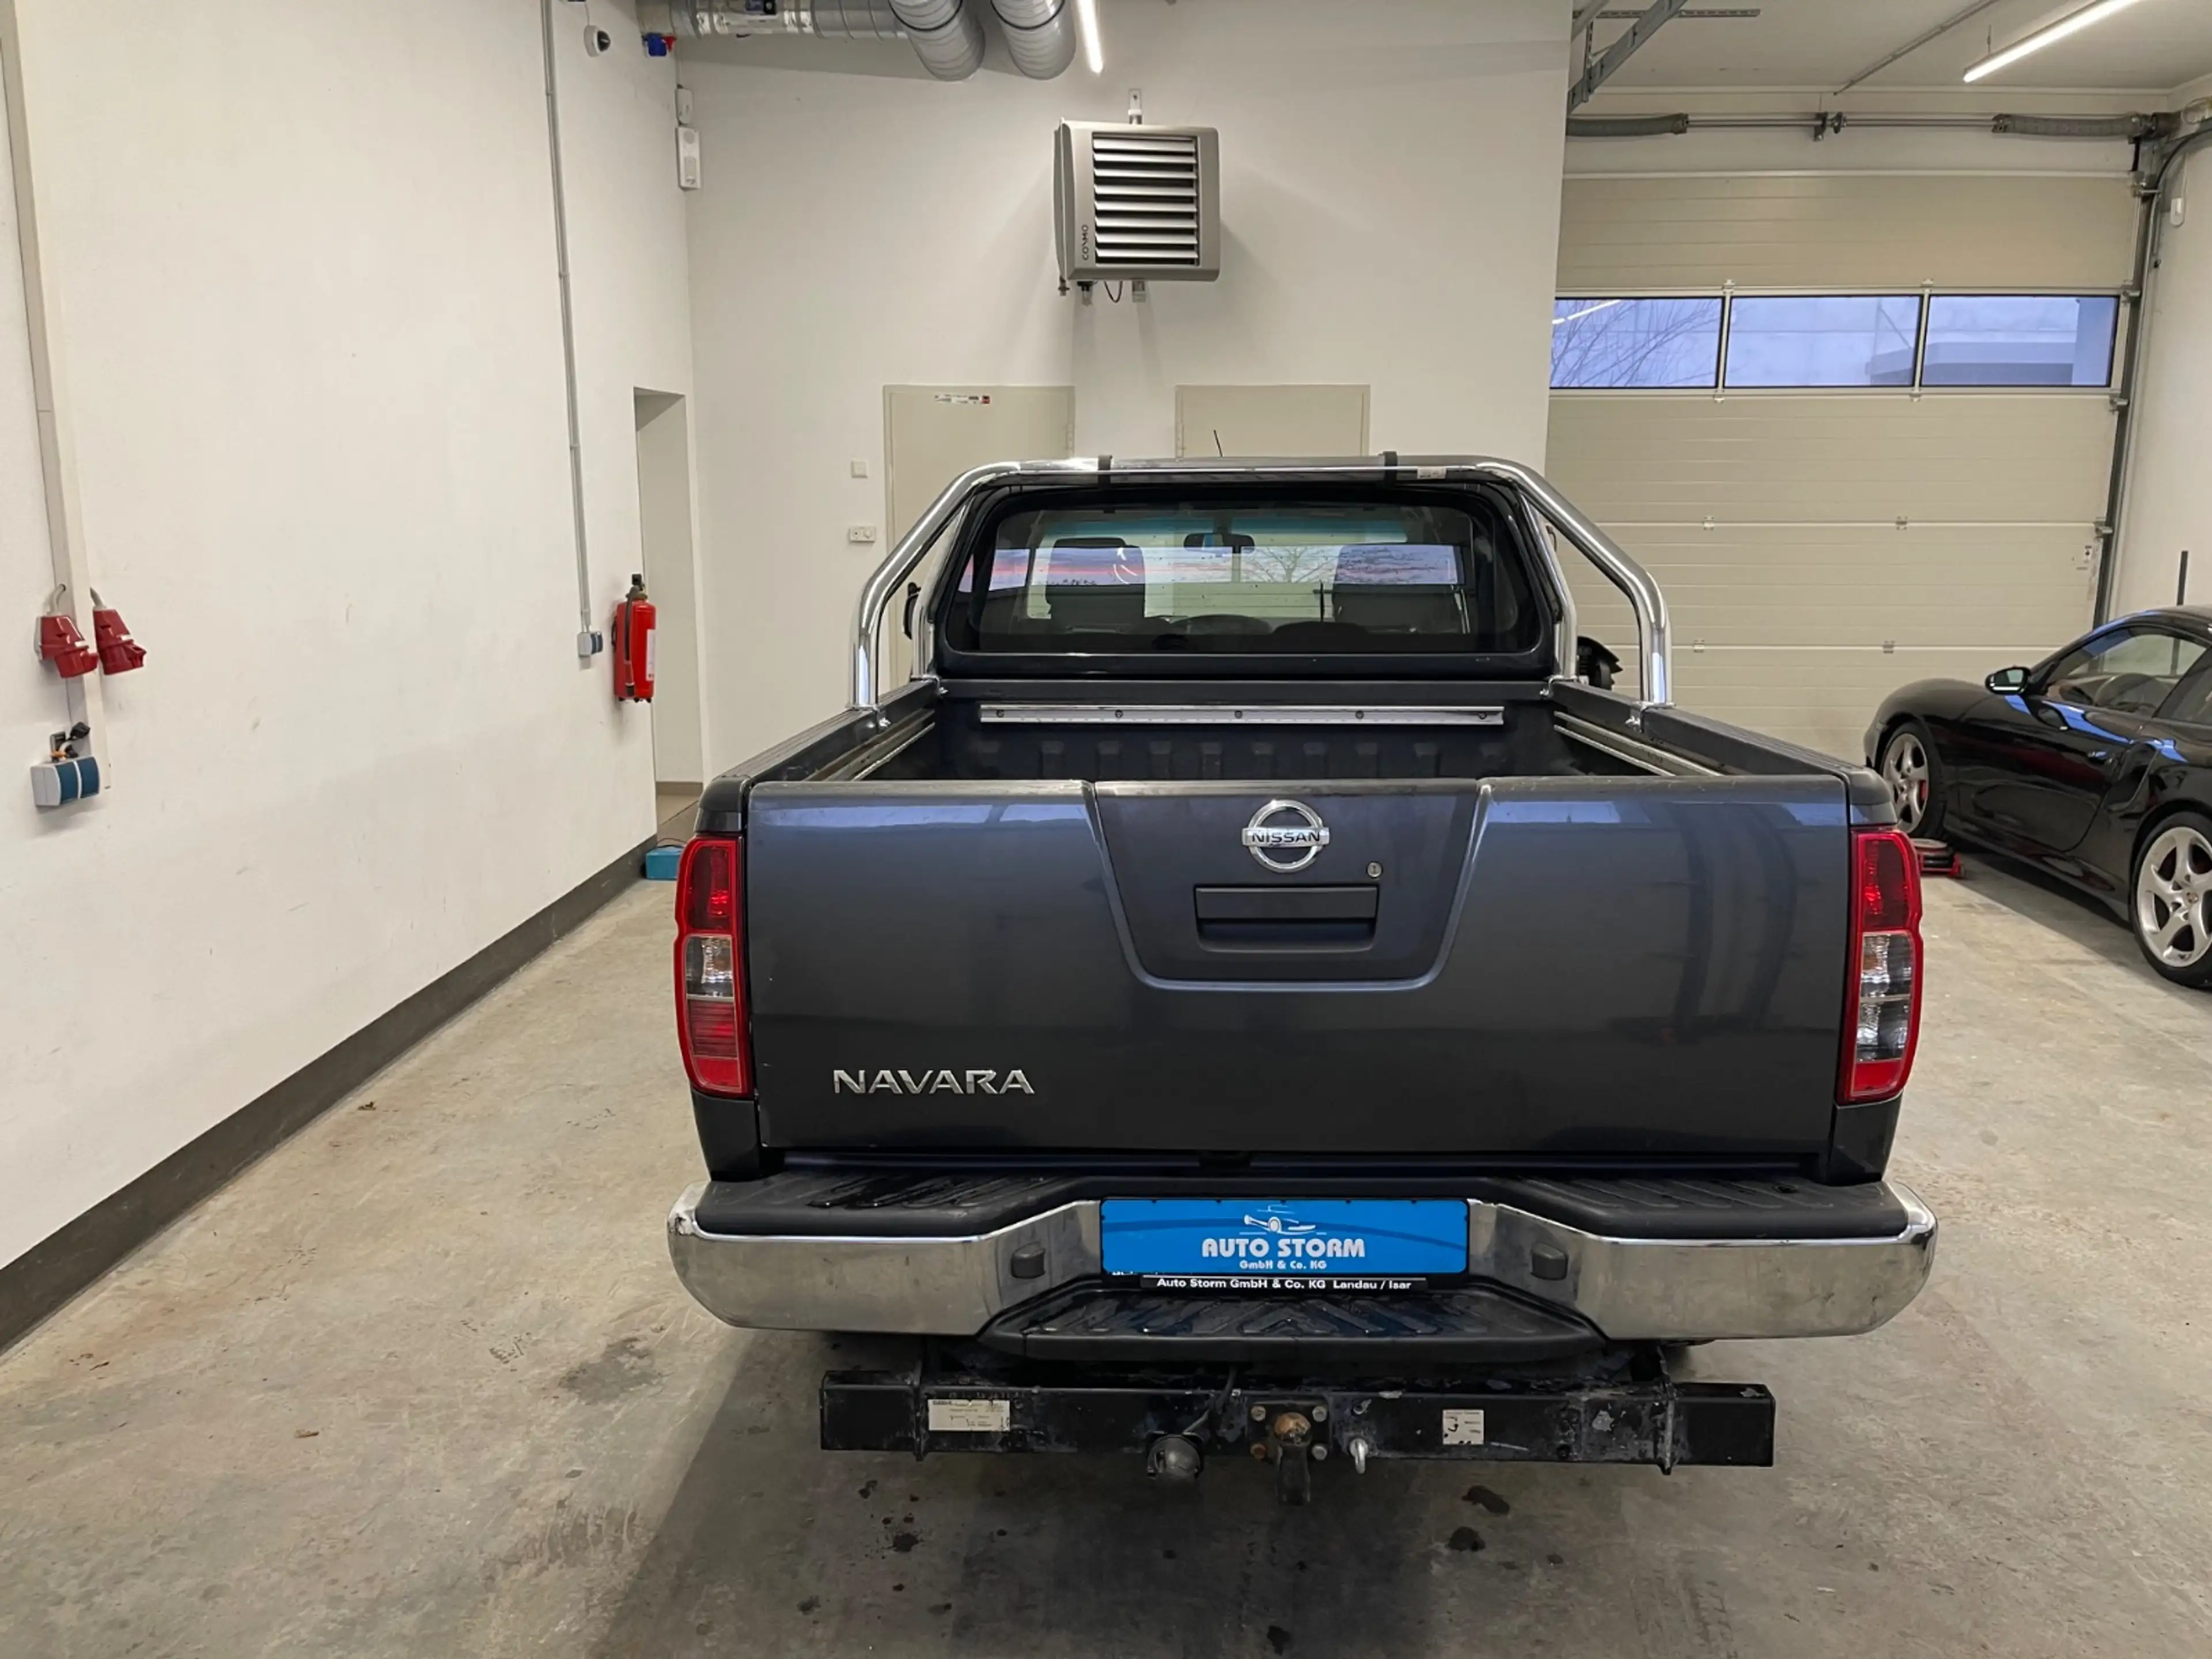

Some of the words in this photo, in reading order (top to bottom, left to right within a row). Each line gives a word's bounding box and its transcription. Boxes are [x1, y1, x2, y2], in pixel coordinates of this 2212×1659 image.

[1251, 831, 1320, 843] NISSAN
[833, 1069, 1035, 1094] NAVARA
[1202, 1238, 1270, 1257] AUTO
[1278, 1238, 1365, 1257] STORM
[1239, 1260, 1273, 1269] GmbH
[1277, 1260, 1286, 1269] &
[1290, 1260, 1306, 1270] Co.
[1310, 1260, 1327, 1270] KG
[1157, 1278, 1187, 1287] Auto
[1190, 1278, 1226, 1287] Storm
[1230, 1279, 1267, 1288] GmbH
[1272, 1279, 1281, 1288] &
[1285, 1280, 1304, 1289] Co.
[1309, 1280, 1326, 1289] KG
[1333, 1280, 1377, 1289] Landau
[1389, 1280, 1411, 1289] Isar
